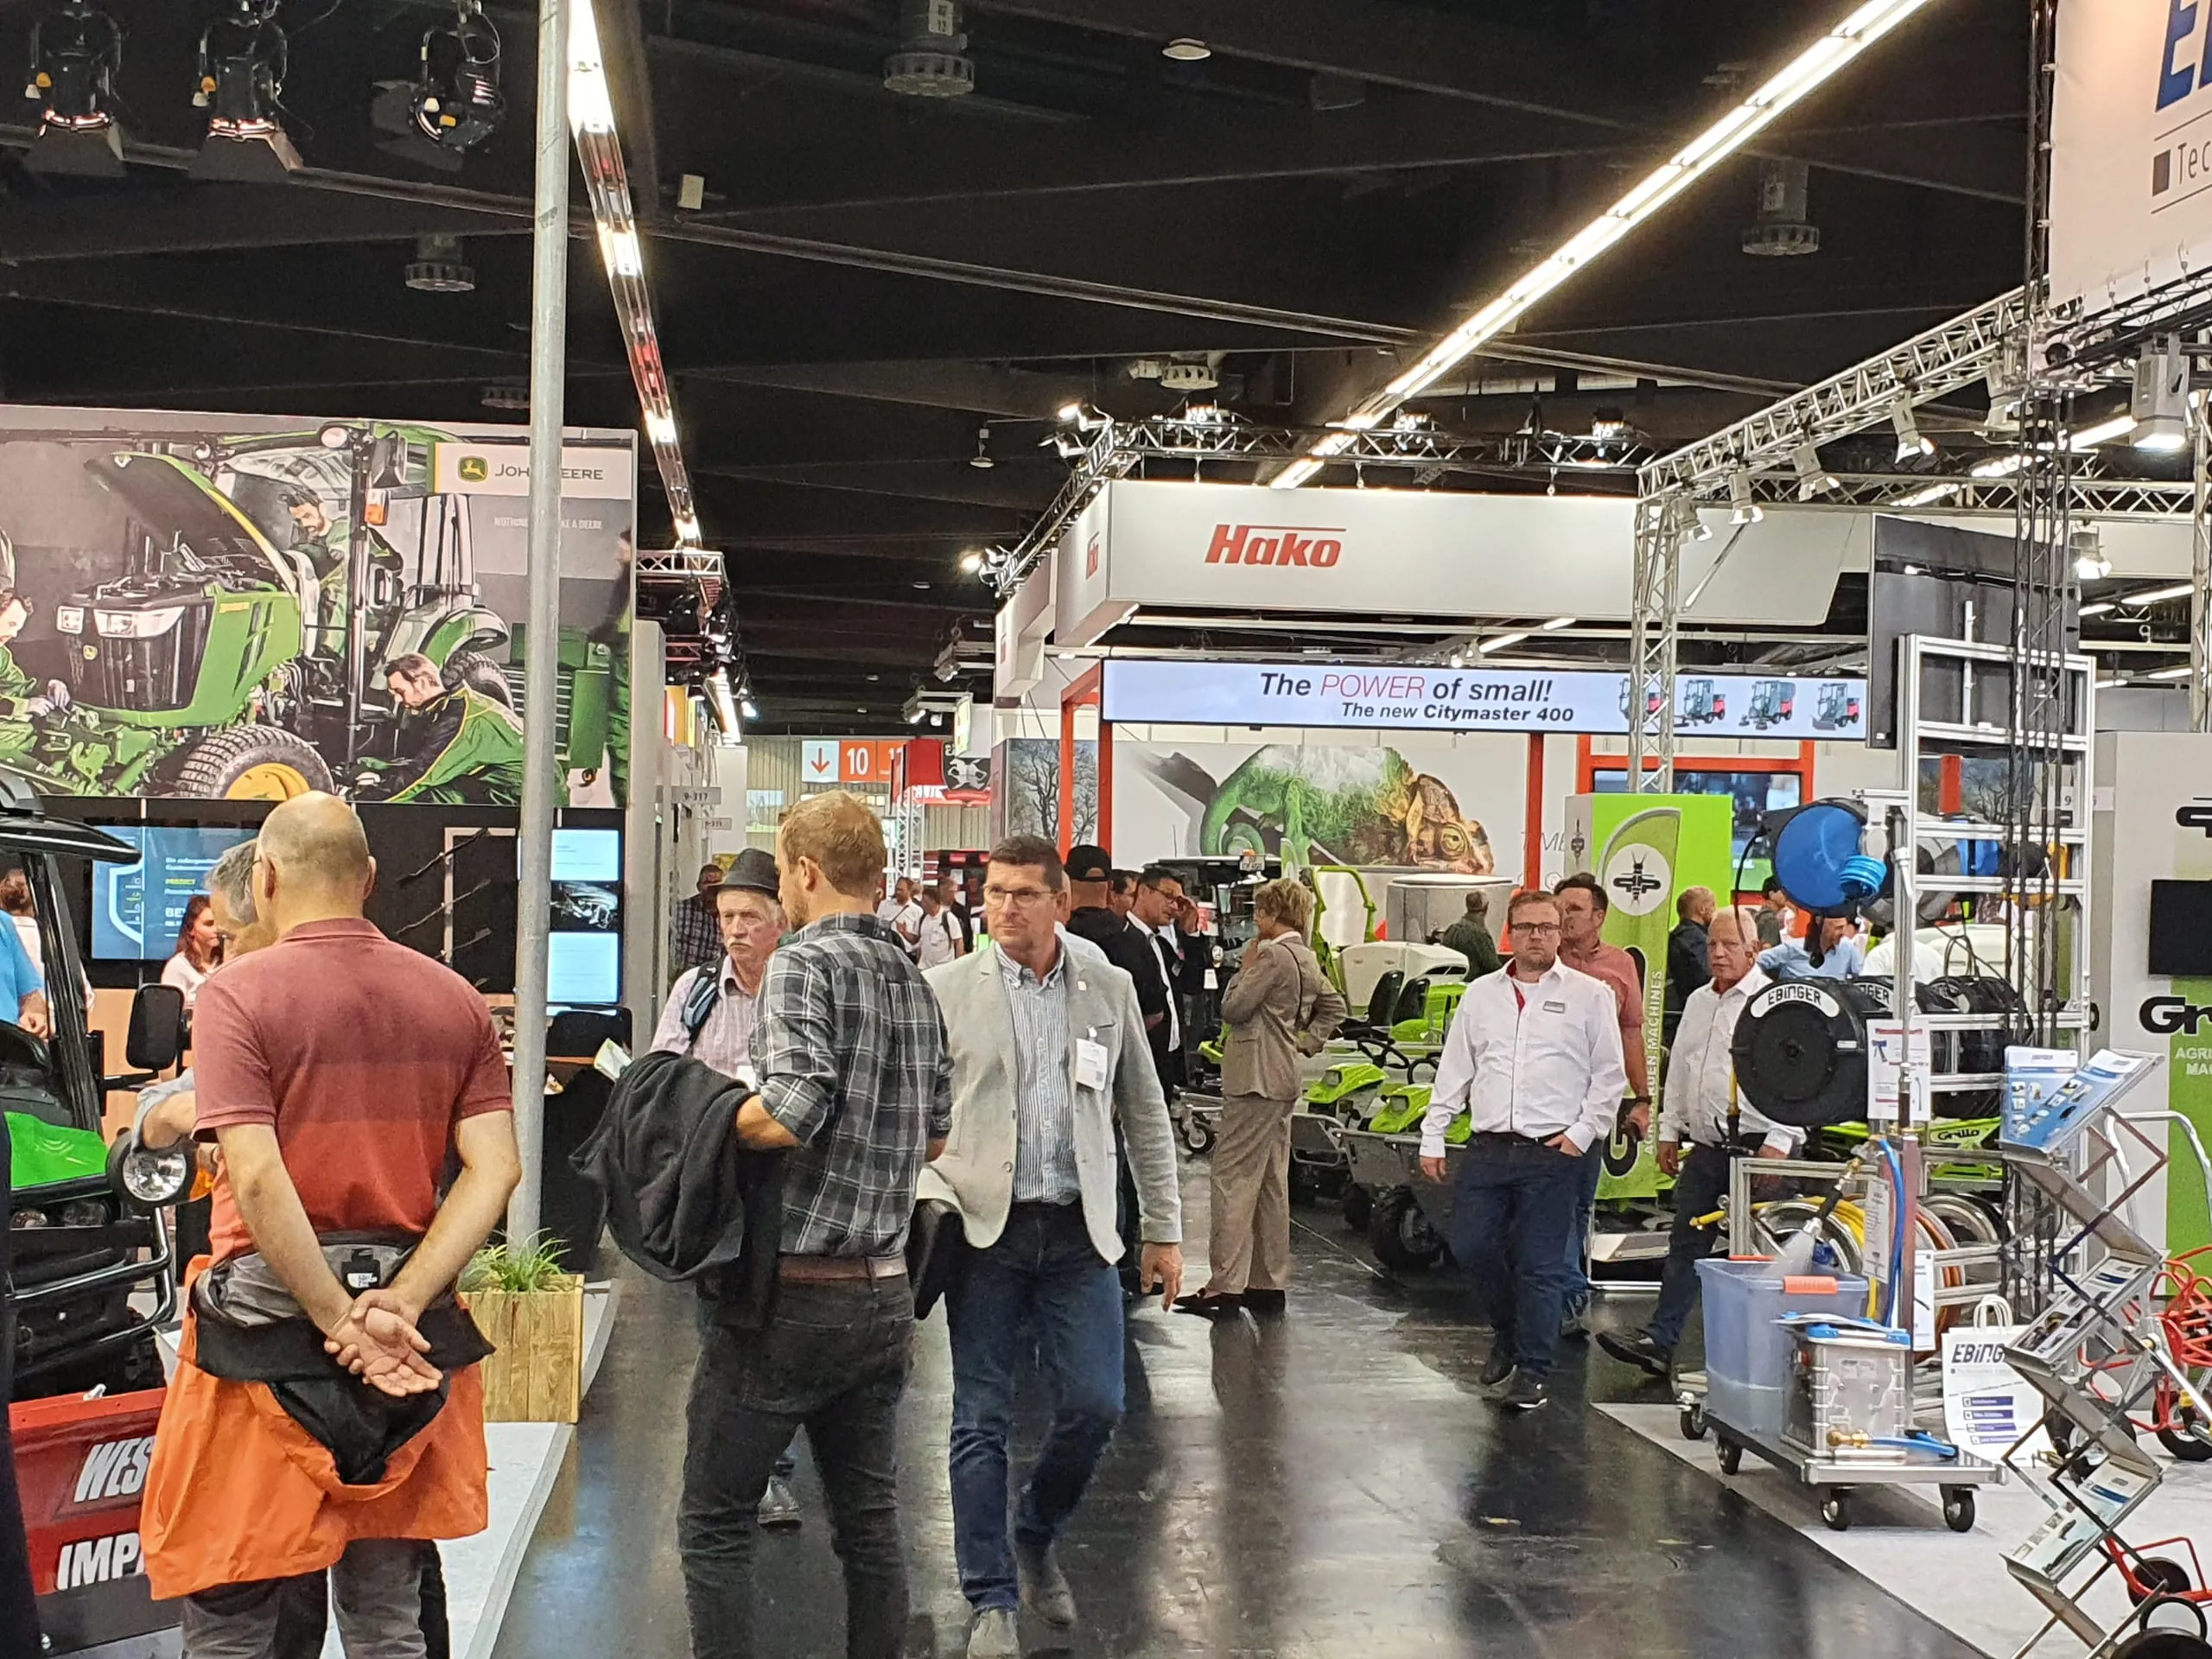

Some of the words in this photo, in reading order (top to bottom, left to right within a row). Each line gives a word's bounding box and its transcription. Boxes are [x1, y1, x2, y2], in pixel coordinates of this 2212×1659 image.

[2155, 0, 2212, 112] E
[494, 463, 530, 477] JOH
[562, 468, 604, 480] EERE
[1205, 524, 1347, 568] Hako
[1261, 673, 1311, 696] The
[1320, 674, 1426, 699] POWER
[1433, 677, 1462, 700] of
[1469, 679, 1553, 702] small!
[1342, 702, 1375, 717] The
[1380, 705, 1418, 718] new
[1423, 704, 1530, 722] Citymaster
[1537, 708, 1573, 721] 400
[847, 747, 869, 776] 10
[1647, 970, 1663, 1049] MACHINES
[1767, 986, 1821, 1006] EBINGER
[1937, 1128, 1980, 1141] Grillo
[73, 1436, 156, 1503] WES
